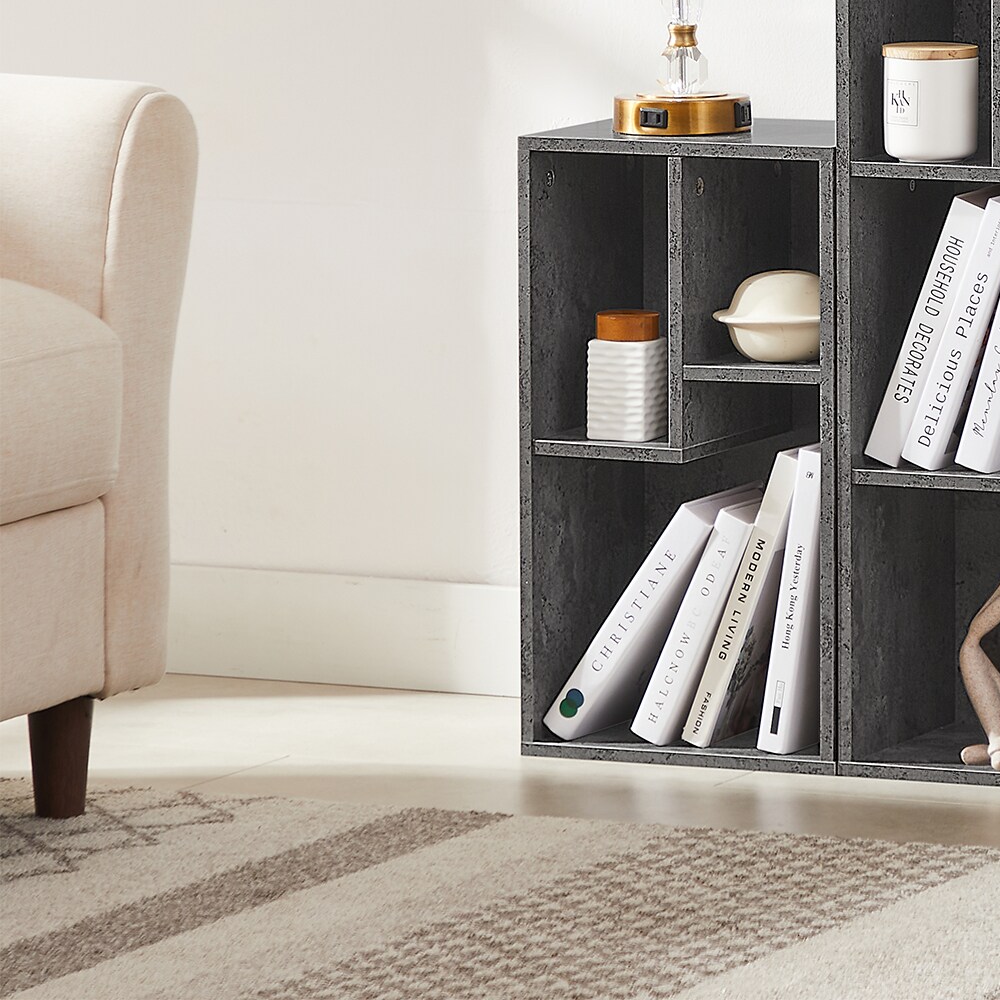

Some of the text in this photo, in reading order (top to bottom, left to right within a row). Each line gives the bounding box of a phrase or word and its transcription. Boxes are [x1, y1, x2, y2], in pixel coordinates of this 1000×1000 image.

[894, 236, 964, 404] HOUSEHOLD DECORATES
[918, 272, 988, 448] Delicious Places
[591, 549, 677, 673] CHRISTIANE
[718, 538, 766, 661] MODERN LIVING
[780, 543, 806, 650] Hong Kong Yesterday
[692, 691, 712, 735] FASHION
